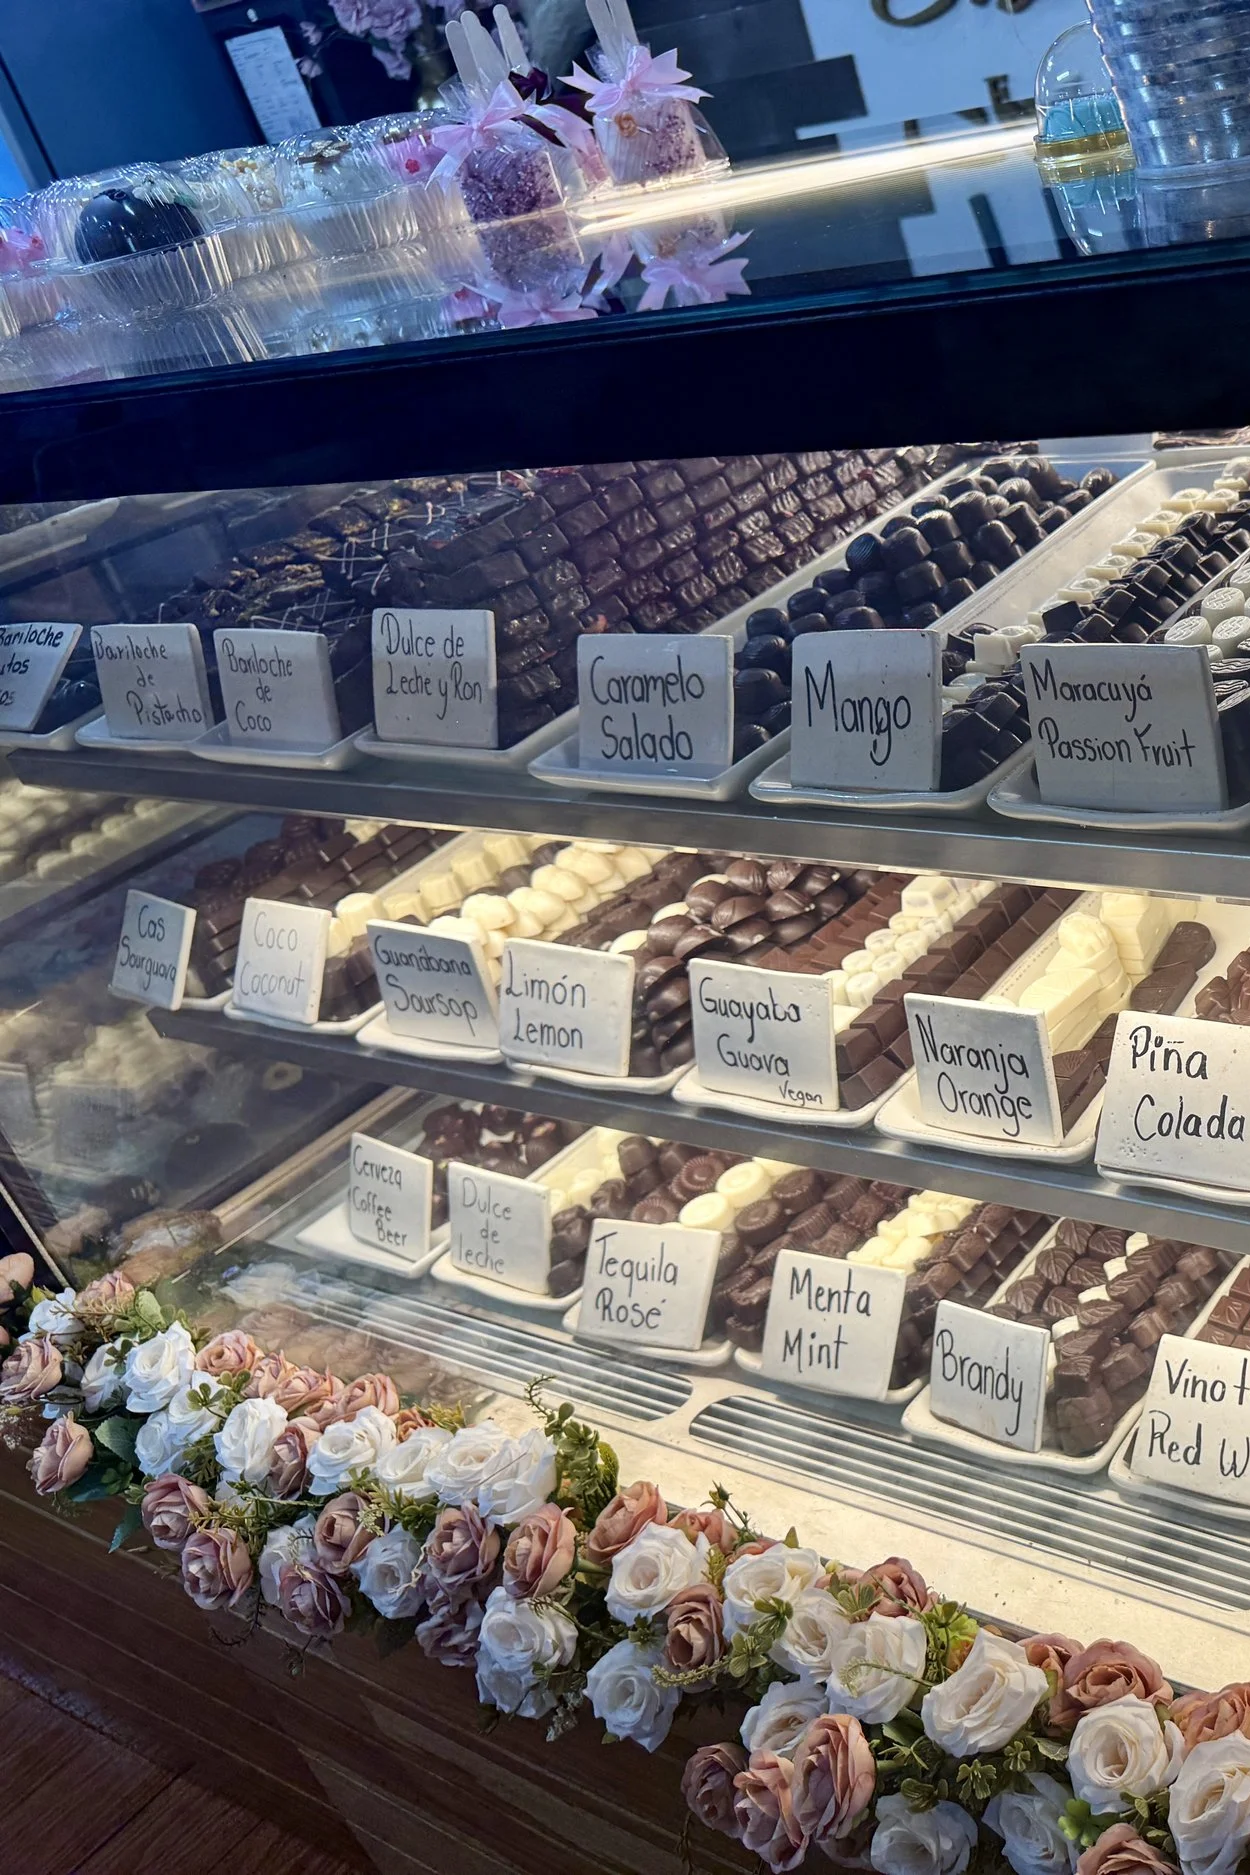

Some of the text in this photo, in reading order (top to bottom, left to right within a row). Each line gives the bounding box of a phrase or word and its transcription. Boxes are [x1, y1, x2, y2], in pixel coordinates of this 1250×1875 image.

[222, 638, 293, 677] Bariloche
[381, 612, 464, 658] Dulce de
[136, 665, 153, 687] de
[256, 677, 272, 702] de
[386, 661, 483, 720] Leche y Ron
[590, 655, 705, 707] Caramelo
[1029, 659, 1153, 722] Maracuyá
[127, 690, 202, 725] Pistacho
[235, 700, 272, 732] Coco
[804, 660, 912, 766] Mango
[600, 712, 694, 763] Salado
[1038, 716, 1197, 768] Passion Fruit
[138, 904, 165, 942] Cas
[253, 911, 298, 951] Coco
[239, 959, 305, 998] Coconut
[505, 949, 586, 1008] Limón
[385, 974, 478, 1037] Soursop
[513, 1007, 583, 1049] Lemon
[700, 976, 801, 1043] Guayaba
[716, 1034, 790, 1077] Guava
[915, 1013, 1029, 1094] Naranja
[1128, 1025, 1209, 1081] Piña
[937, 1071, 1033, 1137] Orange
[1133, 1093, 1245, 1143] Colada
[353, 1145, 402, 1190] Cerveza
[352, 1186, 392, 1222] Coffee
[462, 1176, 512, 1221] Dulce
[375, 1218, 408, 1247] Beer
[480, 1221, 499, 1244] de
[458, 1238, 505, 1275] leche
[595, 1231, 678, 1290] Tequila
[595, 1287, 667, 1329] Rosé
[790, 1266, 871, 1317] Menta
[783, 1324, 848, 1373] Mint
[936, 1328, 1023, 1436] Brandy
[1165, 1358, 1227, 1403] Vino
[1149, 1409, 1202, 1467] Red
